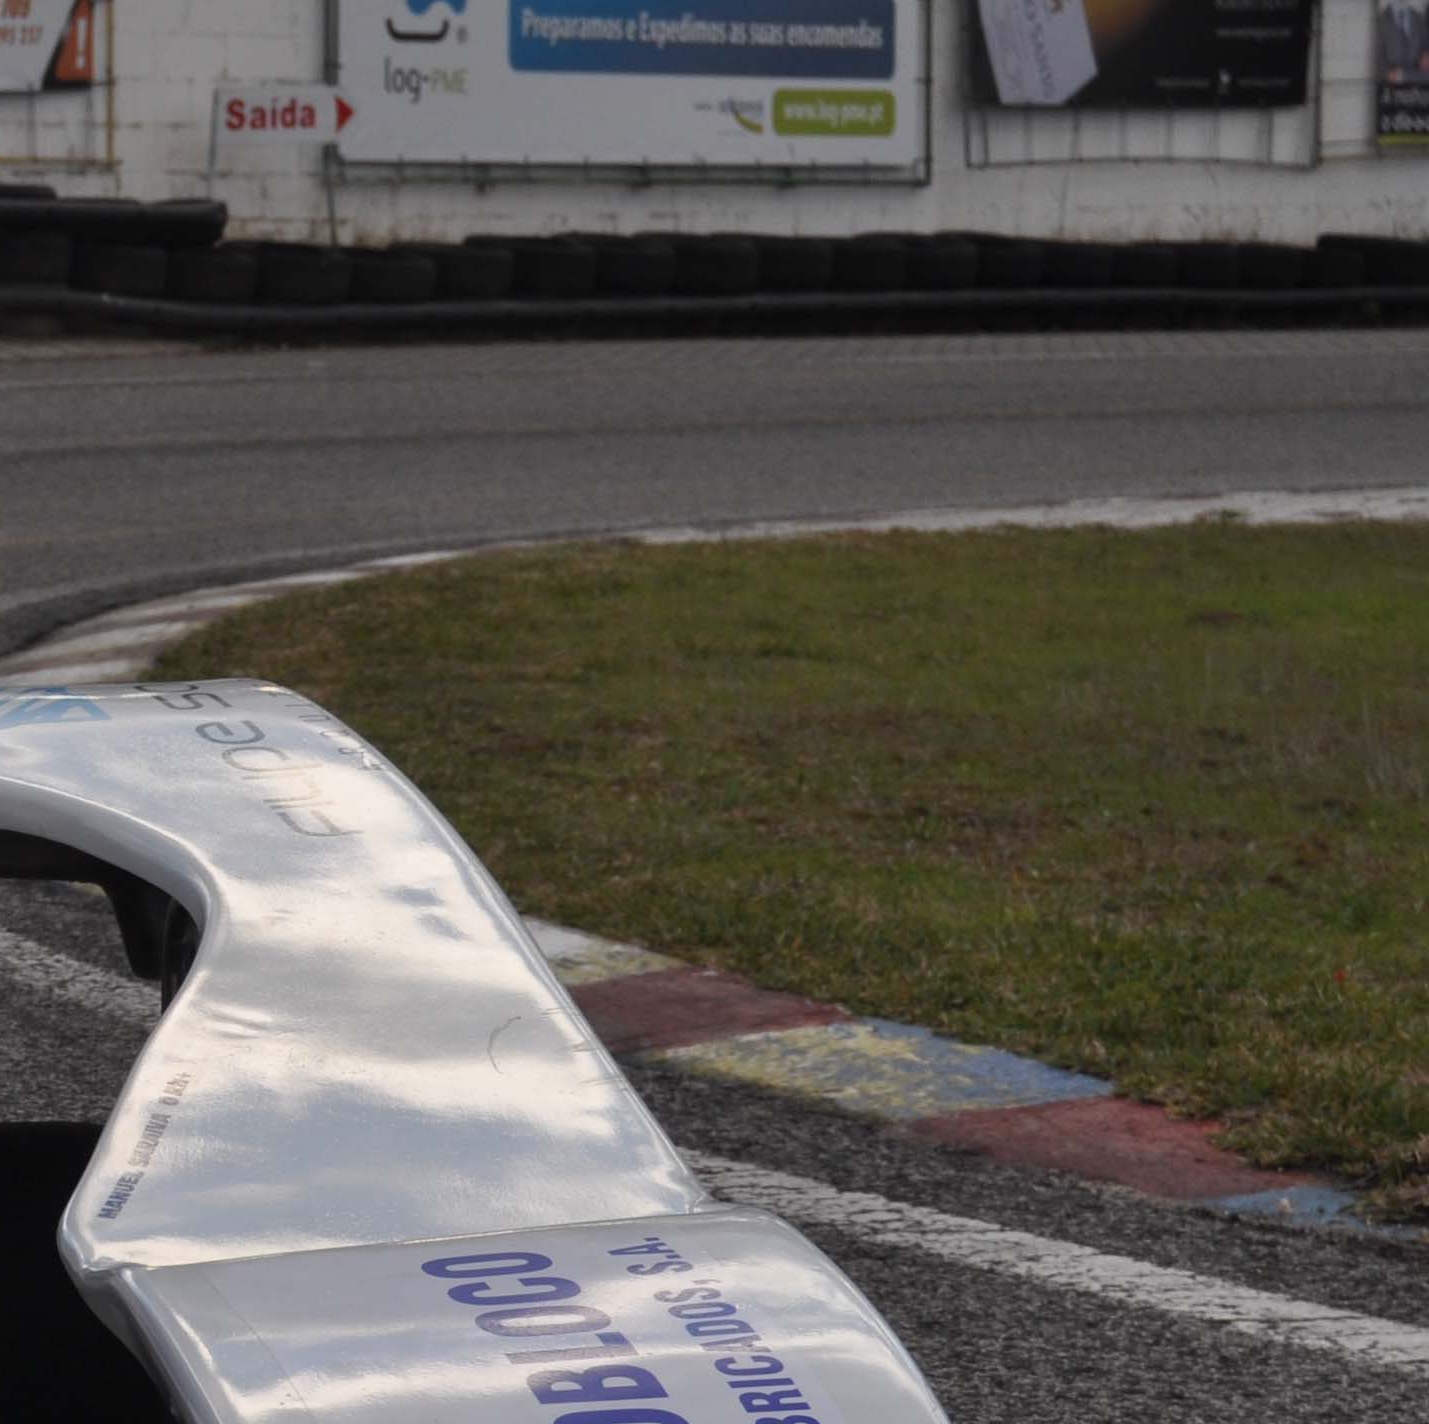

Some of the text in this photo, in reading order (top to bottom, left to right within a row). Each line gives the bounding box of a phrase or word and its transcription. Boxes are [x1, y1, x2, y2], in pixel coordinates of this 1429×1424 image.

[521, 8, 883, 50] Preparamos e Expedimos as suas encomendas
[606, 1236, 694, 1279] S.A.
